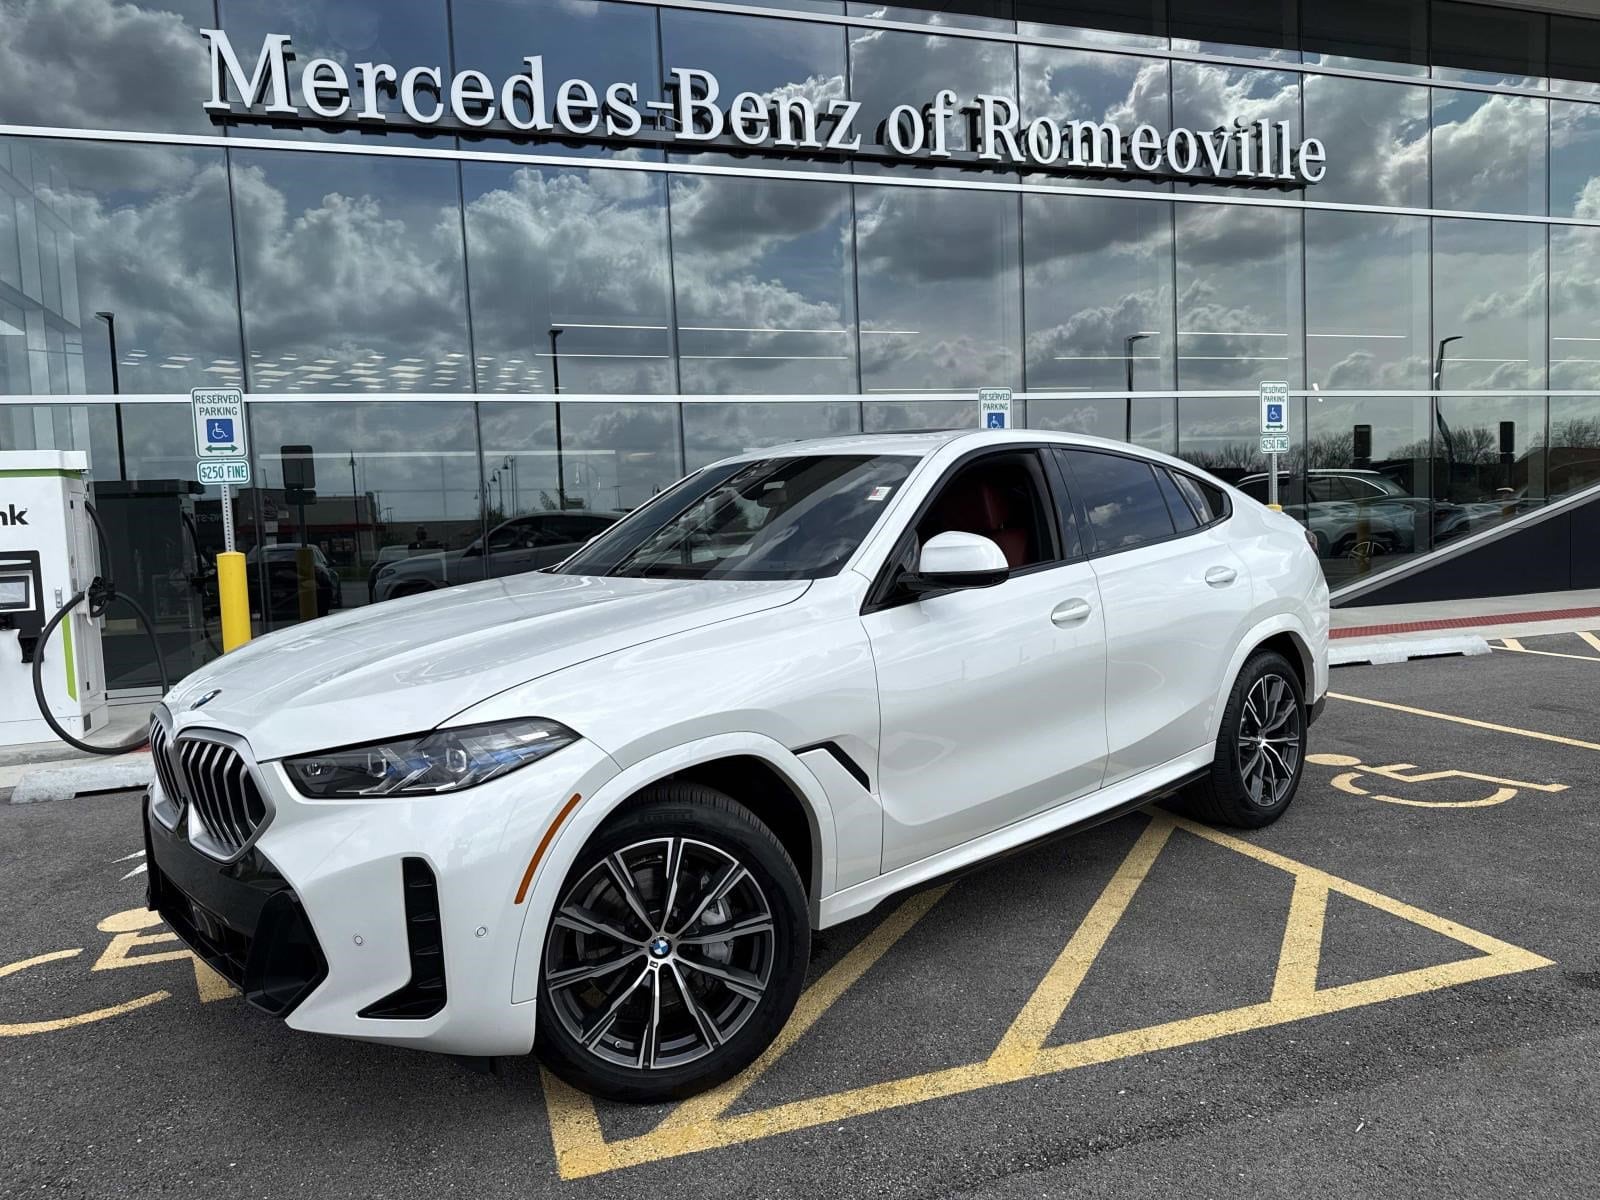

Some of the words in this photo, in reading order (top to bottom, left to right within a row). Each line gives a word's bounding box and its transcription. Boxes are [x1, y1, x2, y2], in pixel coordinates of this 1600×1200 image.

[200, 28, 862, 151] Mercedes-Benz
[889, 89, 957, 156] of
[975, 93, 1327, 183] Romeoville
[1262, 386, 1287, 394] RESERVED
[195, 394, 240, 404] RESERVED
[981, 393, 1010, 401] RESERVED
[199, 406, 238, 416] PARKING
[983, 402, 1009, 411] PARKING
[1276, 439, 1288, 449] FINE
[201, 466, 224, 480] $250
[227, 465, 247, 479] FINE
